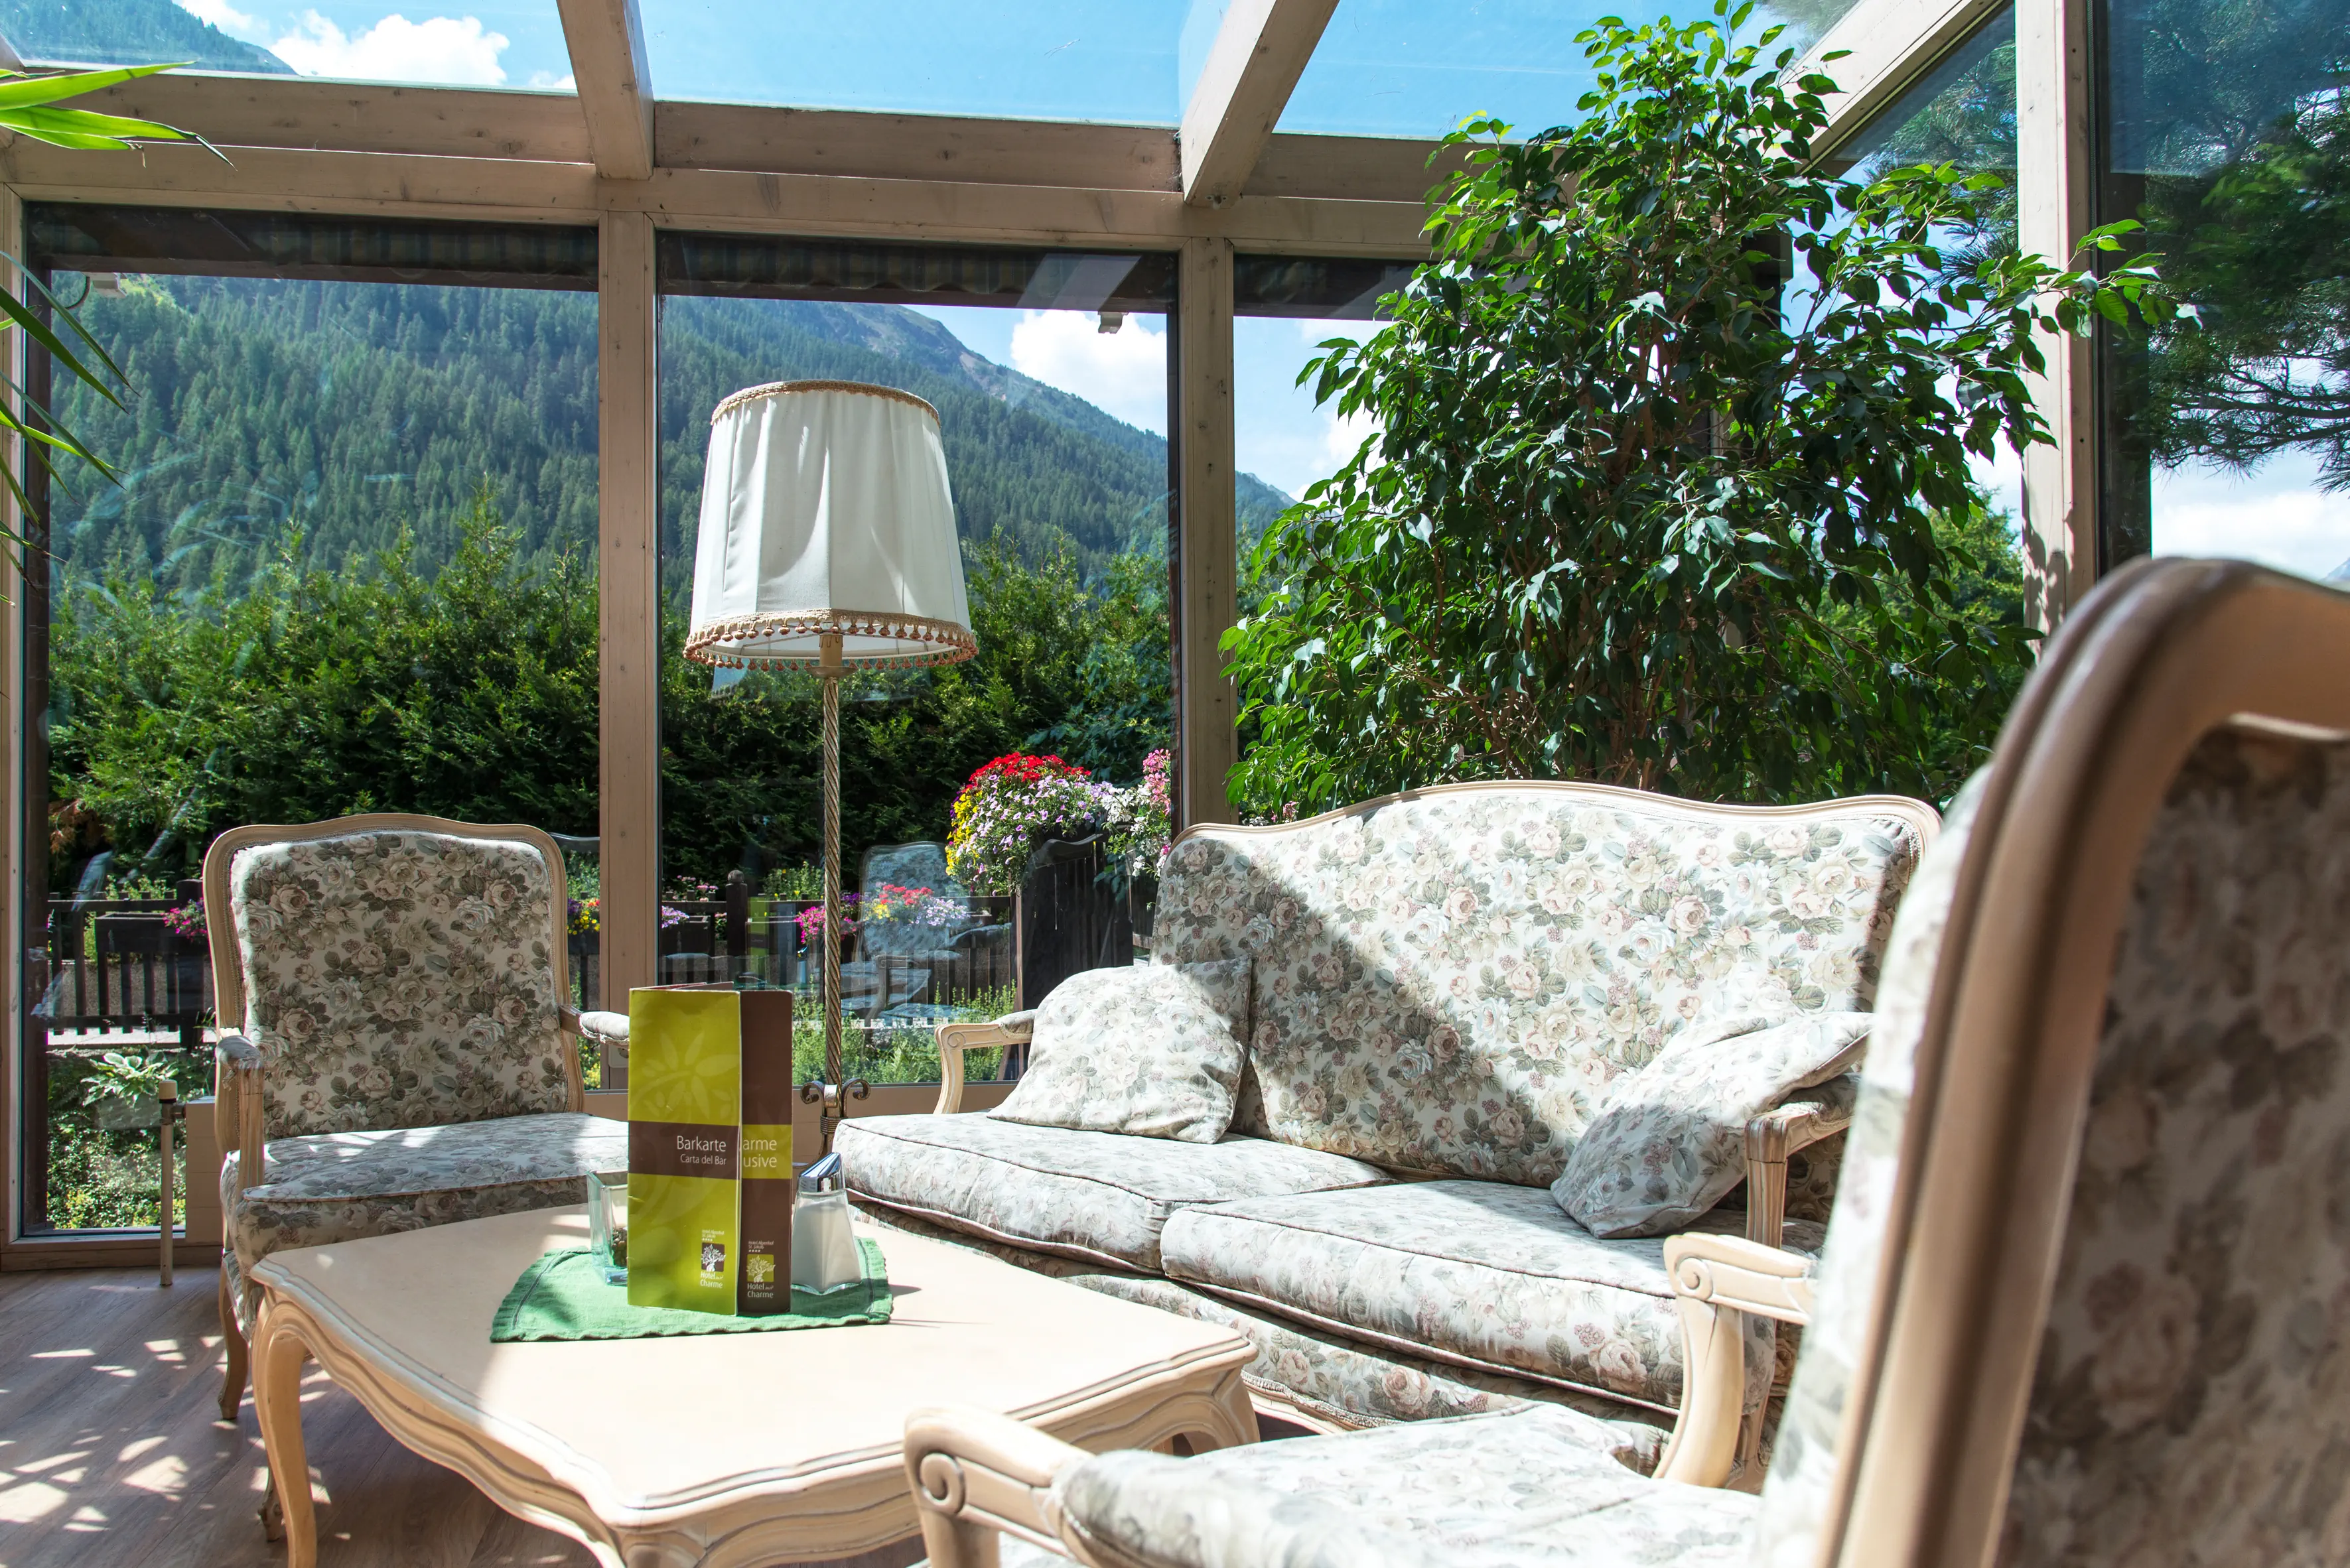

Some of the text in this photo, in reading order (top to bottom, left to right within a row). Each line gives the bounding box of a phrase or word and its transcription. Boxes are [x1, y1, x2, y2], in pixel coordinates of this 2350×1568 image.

[677, 1136, 726, 1151] Barkarte
[742, 1139, 777, 1151] arme
[680, 1154, 726, 1165] Carta del Bar
[743, 1154, 777, 1167] usive
[700, 1279, 723, 1289] Charme
